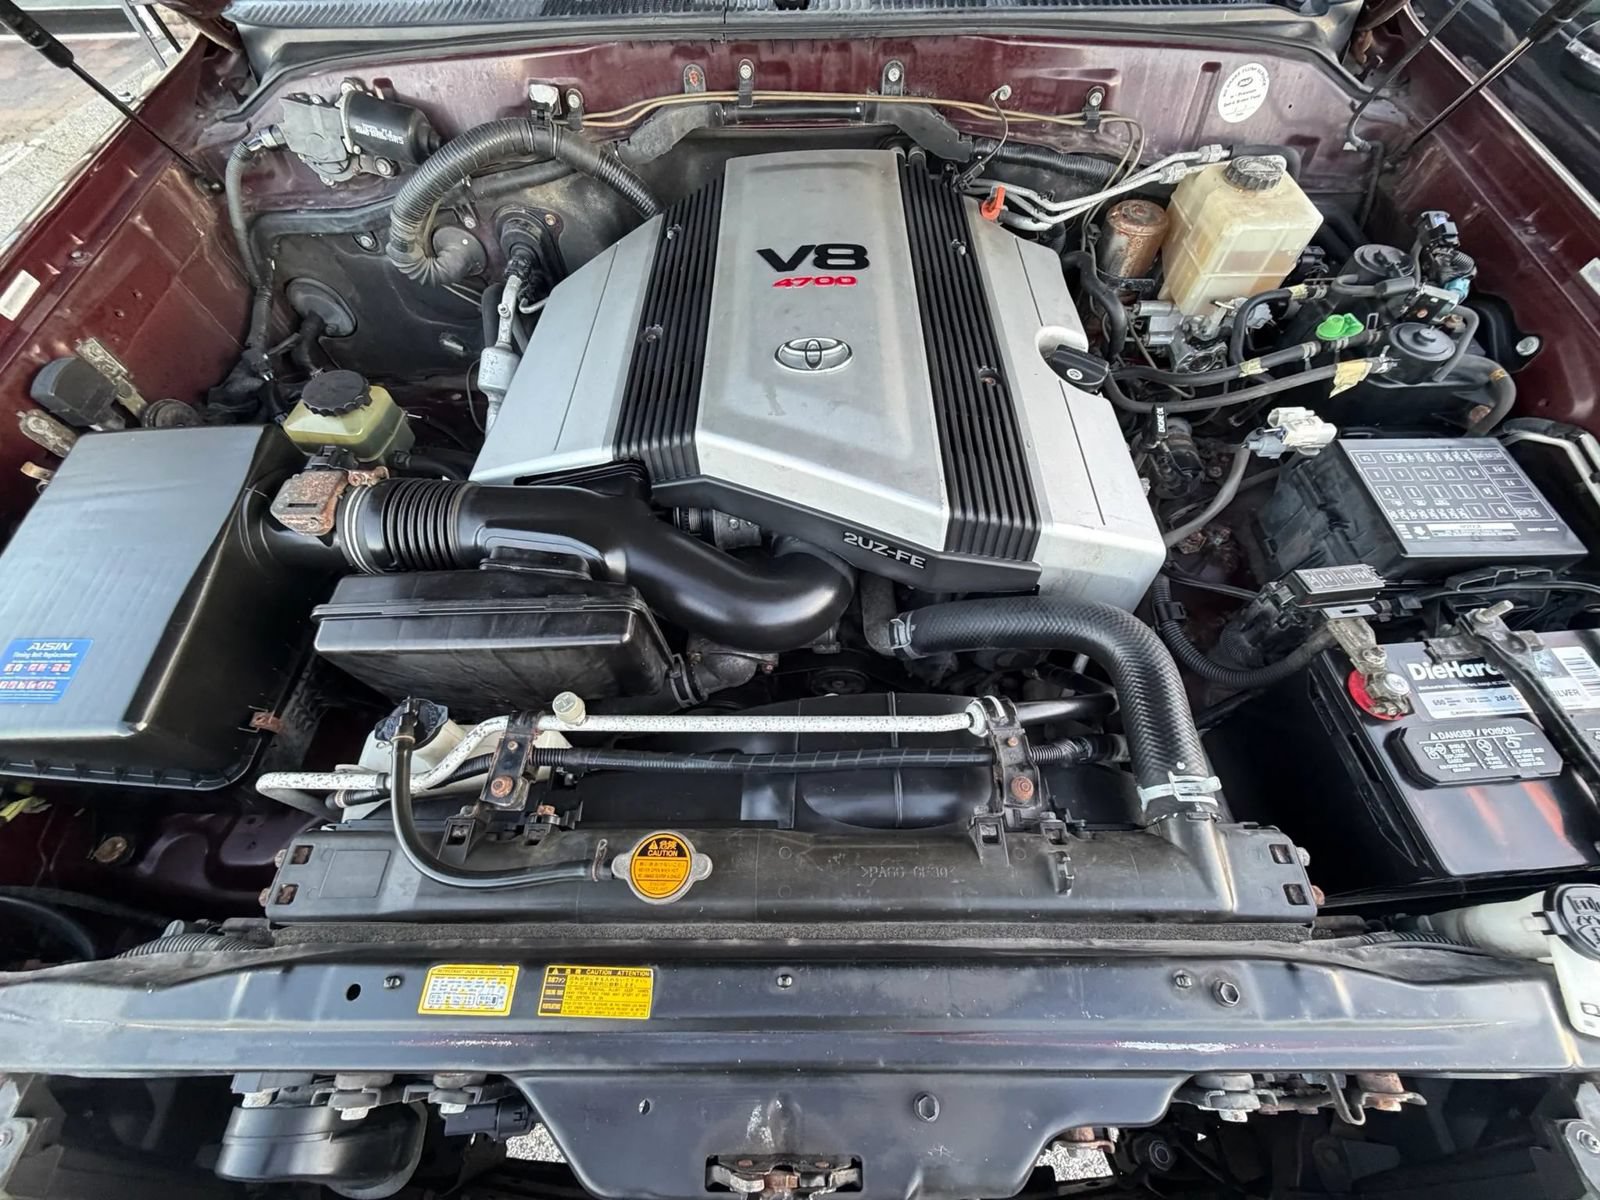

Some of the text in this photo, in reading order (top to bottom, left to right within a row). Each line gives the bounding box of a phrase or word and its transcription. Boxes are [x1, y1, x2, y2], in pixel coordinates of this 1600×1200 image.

[756, 243, 870, 272] V8
[772, 275, 858, 288] 4700
[843, 532, 926, 569] 2UZ-FE
[26, 642, 74, 651] AISIN
[1437, 729, 1475, 740] DANGER
[1482, 726, 1516, 737] POISON
